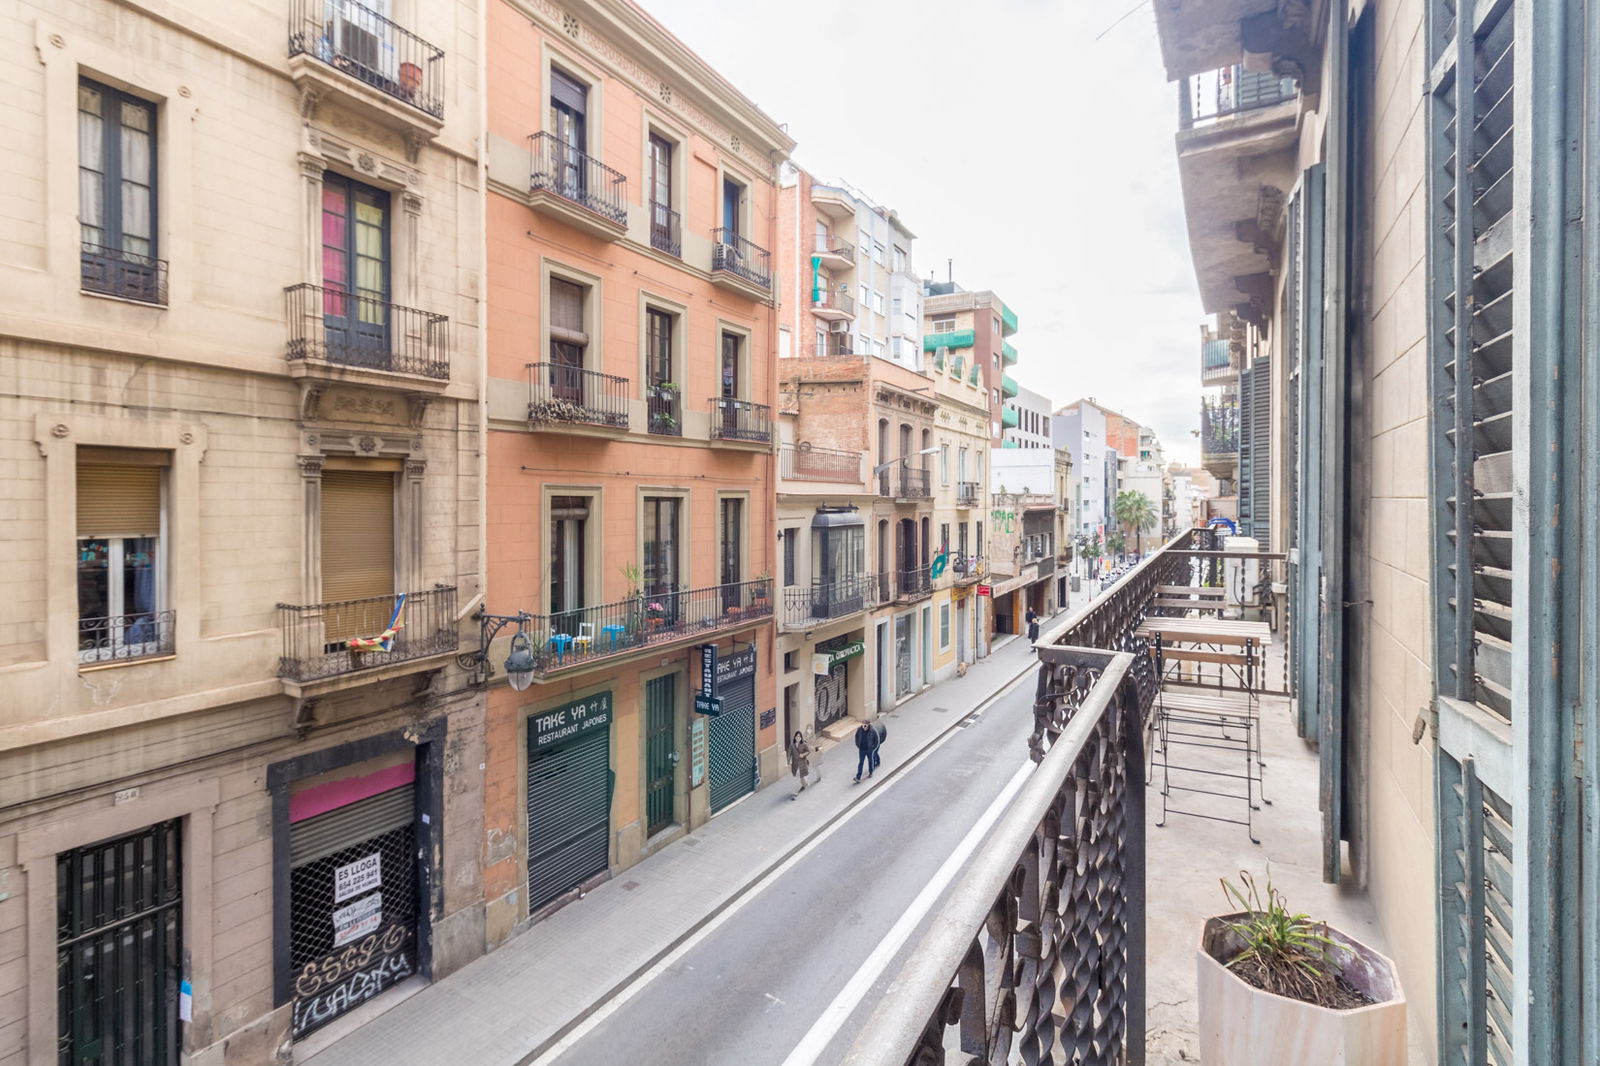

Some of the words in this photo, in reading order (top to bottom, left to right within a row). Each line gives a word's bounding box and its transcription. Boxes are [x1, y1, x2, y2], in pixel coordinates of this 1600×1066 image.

[717, 660, 730, 674] AKE
[696, 700, 710, 710] TAKE
[711, 703, 720, 711] YA
[536, 710, 566, 733] TAKE
[571, 704, 586, 720] YA
[538, 723, 579, 746] RESTAURANT
[582, 713, 607, 730] JAPONES
[338, 869, 349, 881] ES
[351, 858, 378, 875] LLOGA
